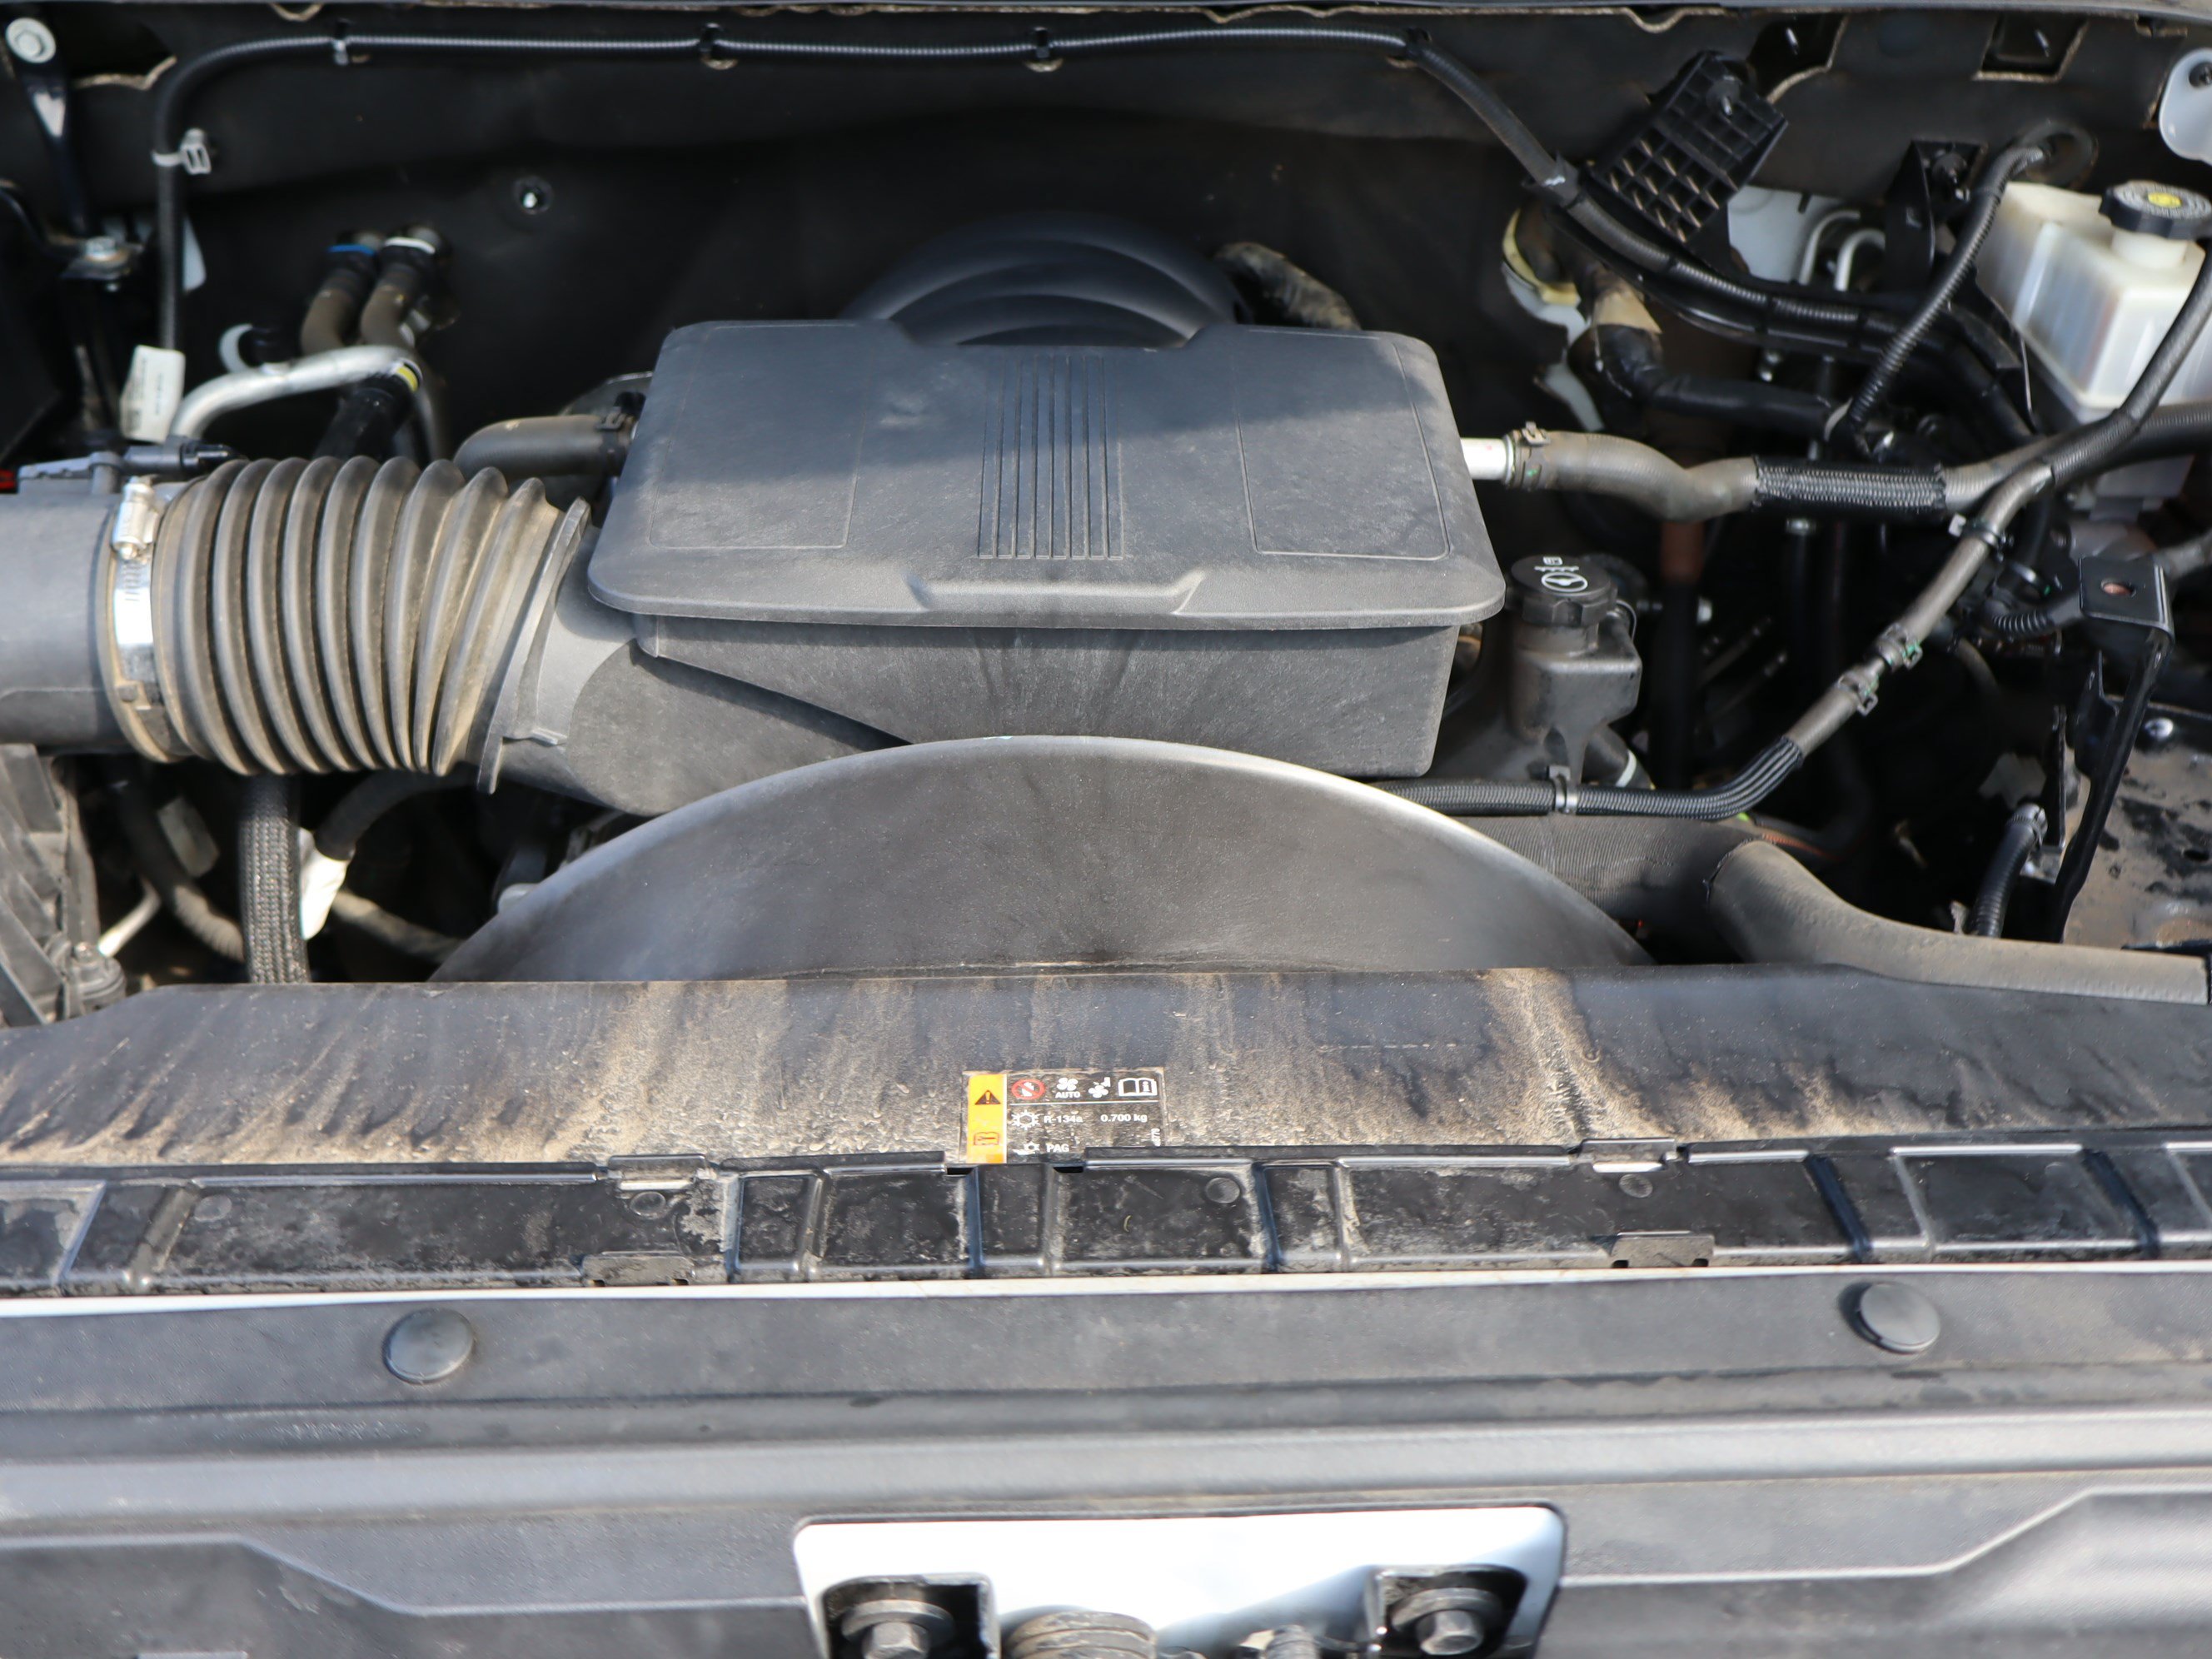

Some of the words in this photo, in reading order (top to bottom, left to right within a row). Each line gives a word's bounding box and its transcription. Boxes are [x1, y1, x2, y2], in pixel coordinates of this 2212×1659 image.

[1043, 1114, 1084, 1123] R-134a
[1100, 1113, 1132, 1123] 0.700
[1133, 1113, 1148, 1123] kg
[1046, 1143, 1070, 1153] PAG
